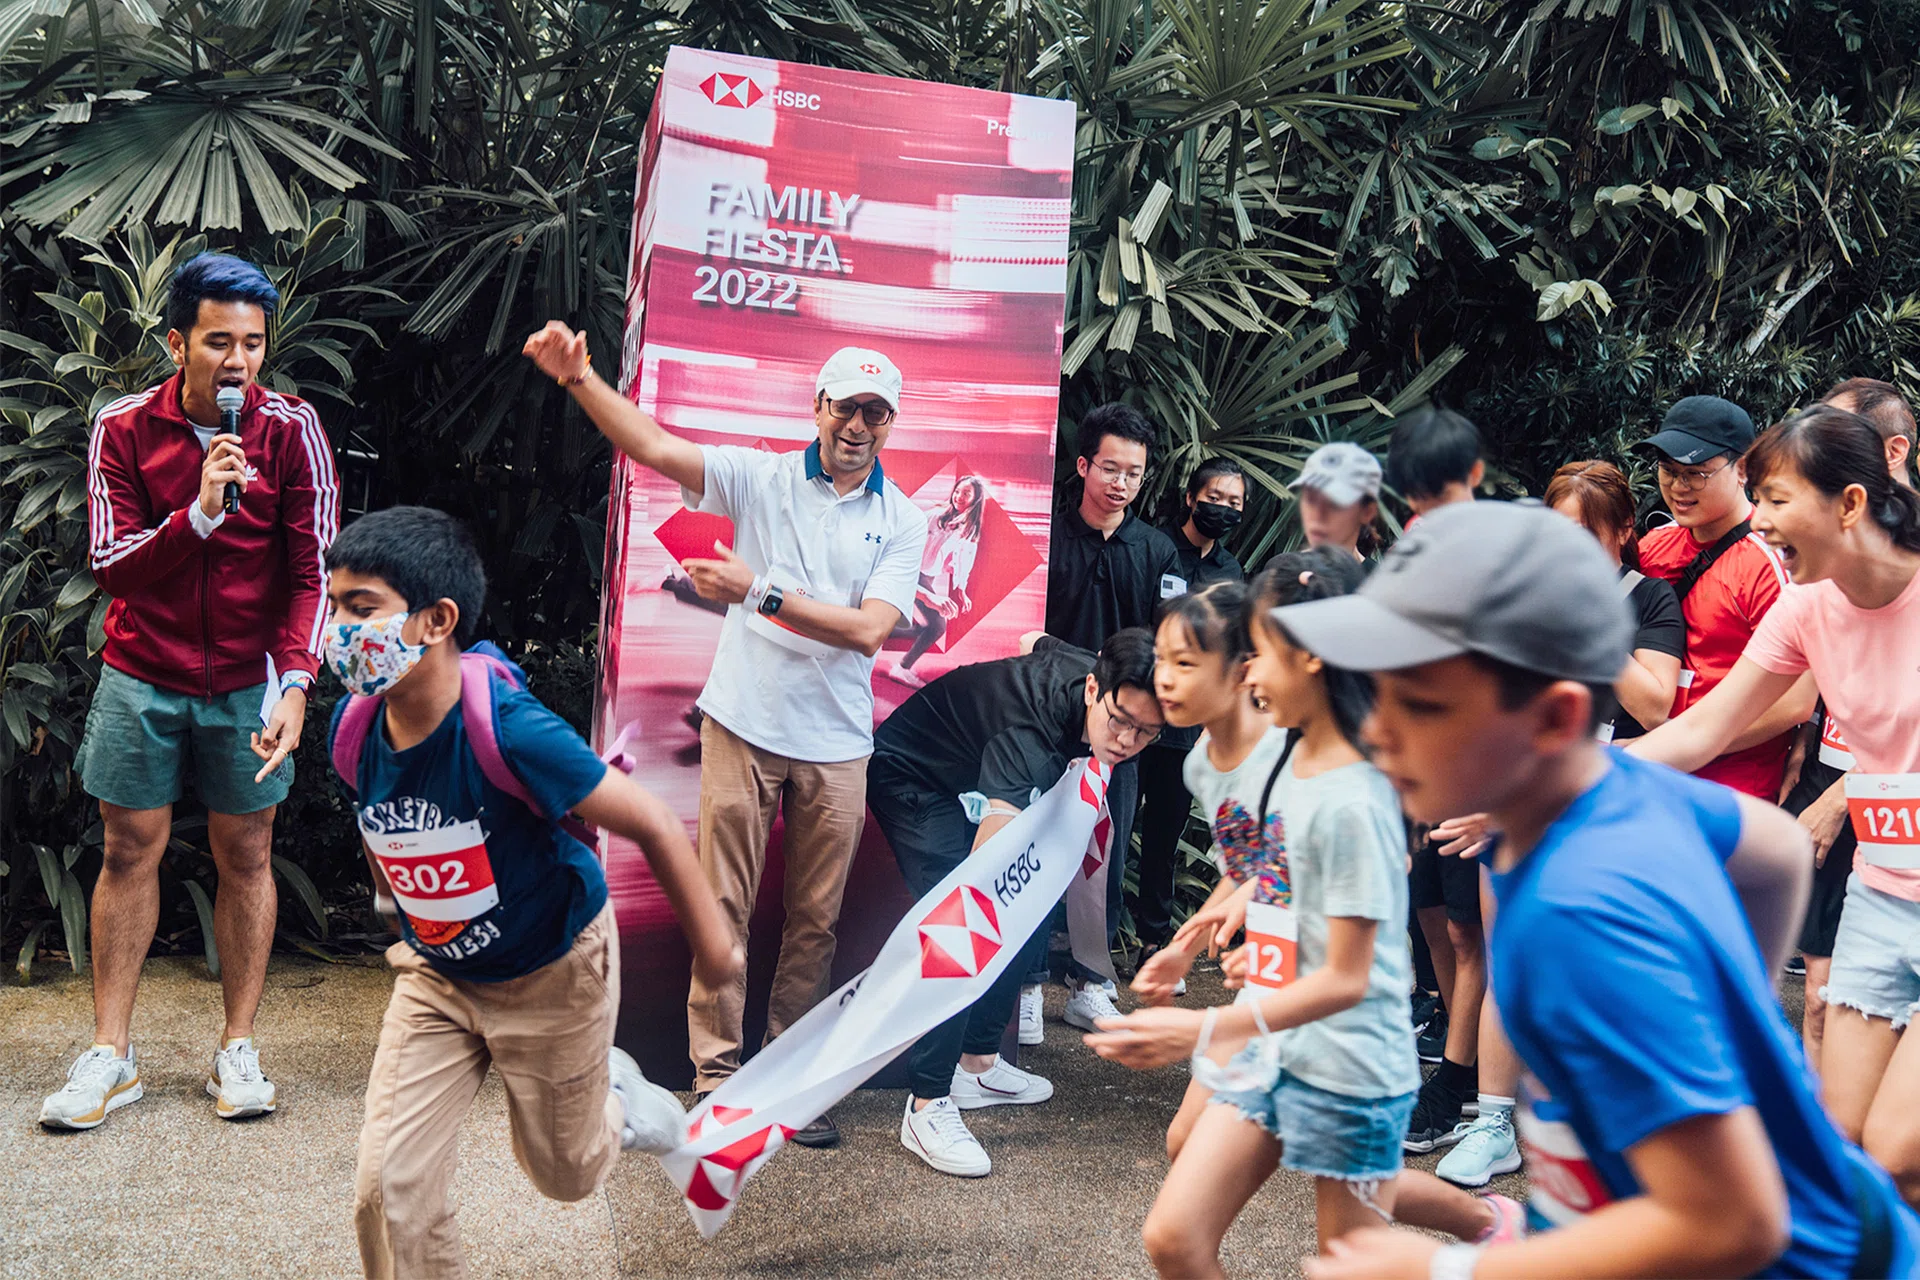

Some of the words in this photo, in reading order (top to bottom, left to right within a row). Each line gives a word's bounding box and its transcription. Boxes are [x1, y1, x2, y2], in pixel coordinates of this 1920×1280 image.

[769, 89, 821, 111] HSBC
[707, 180, 860, 227] FAMILY
[703, 225, 842, 271] FIESTA
[692, 266, 797, 310] 2022
[994, 841, 1041, 908] HSBC
